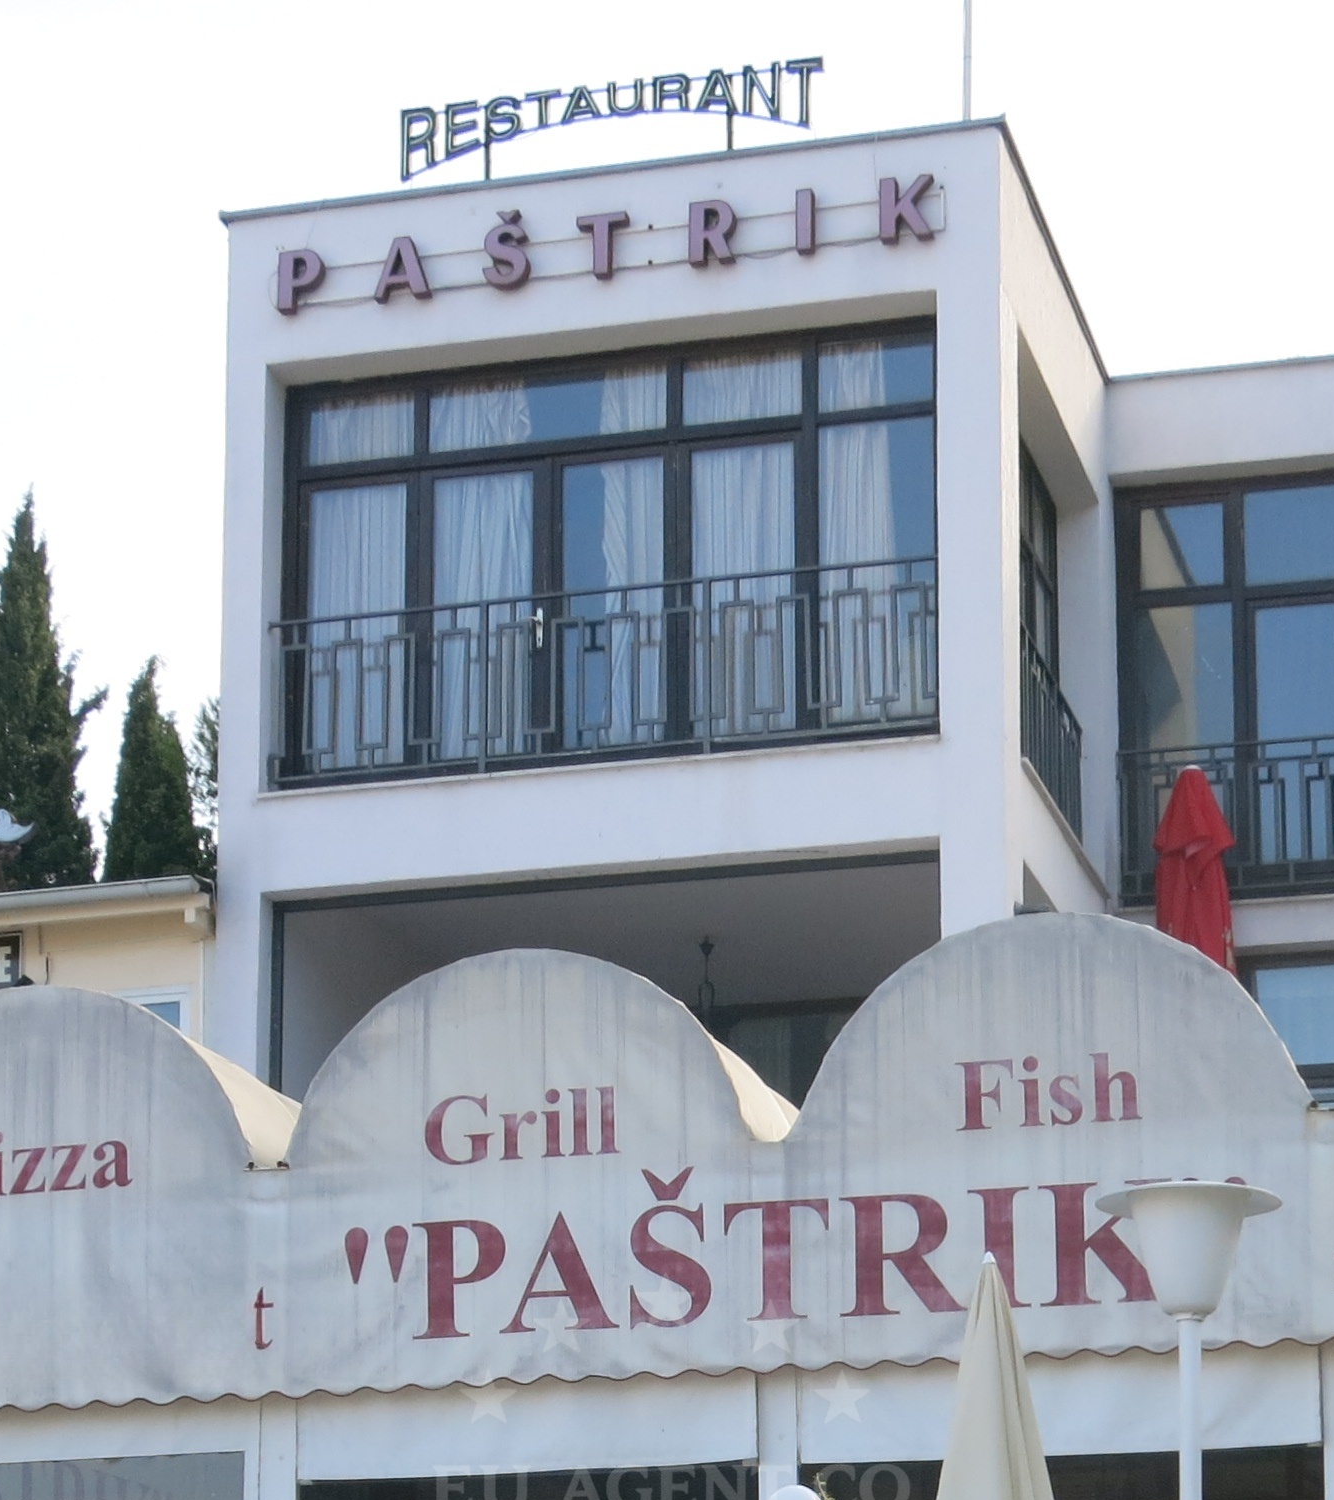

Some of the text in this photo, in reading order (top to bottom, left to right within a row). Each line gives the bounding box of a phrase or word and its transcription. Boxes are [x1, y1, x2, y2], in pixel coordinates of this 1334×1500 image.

[400, 56, 823, 181] RESTAURANT
[277, 173, 935, 316] PAŠTRIK
[424, 1086, 620, 1166] Grill
[956, 1052, 1142, 1132] Fish
[344, 1166, 1249, 1340] "PAŠTRIK
